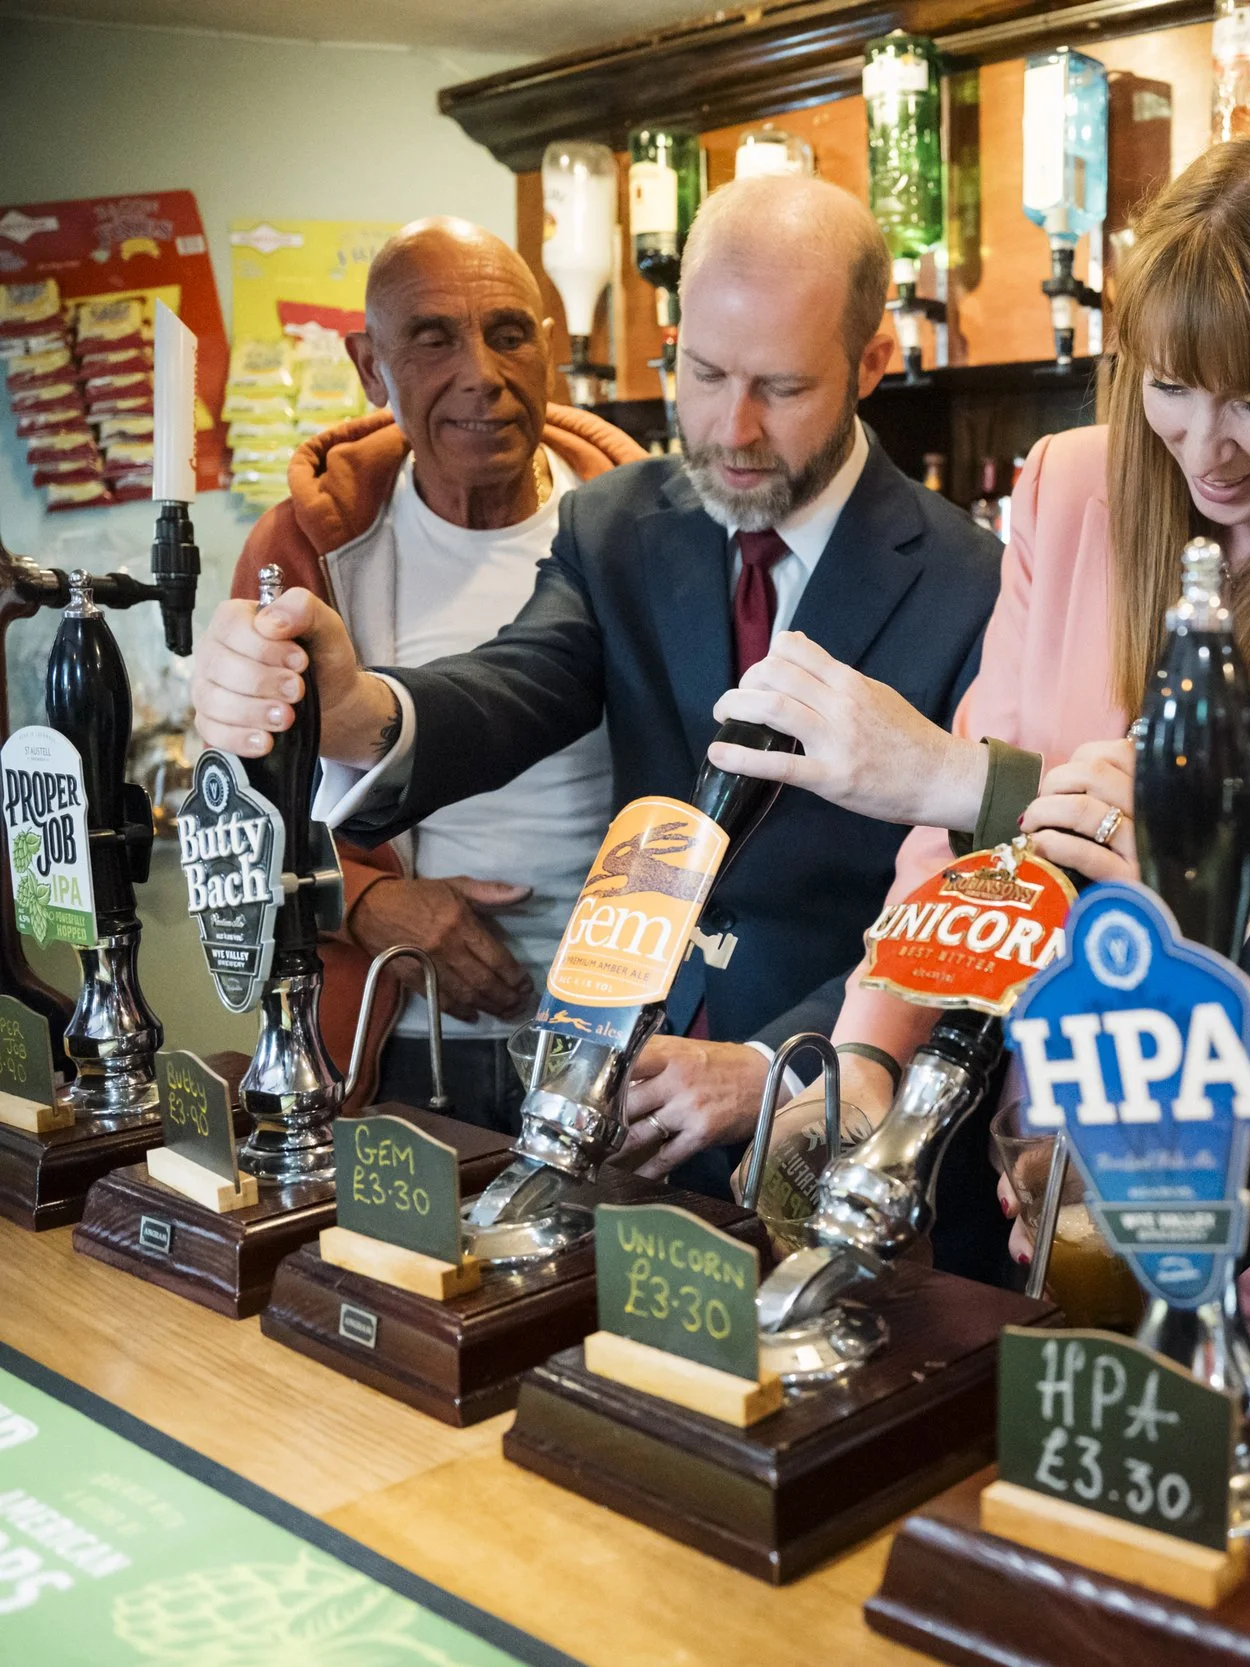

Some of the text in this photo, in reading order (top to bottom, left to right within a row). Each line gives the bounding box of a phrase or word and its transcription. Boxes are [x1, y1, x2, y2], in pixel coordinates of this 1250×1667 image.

[6, 768, 81, 828] PROPER
[37, 812, 77, 877] JOB
[178, 811, 271, 866] Butty
[51, 873, 84, 907] IPA
[184, 851, 273, 912] Bach
[56, 923, 87, 941] HOPPED
[568, 897, 673, 962] Gem
[597, 961, 628, 977] AMBER
[630, 969, 651, 981] ALE
[898, 946, 996, 973] BEST BITTER
[166, 1060, 208, 1114] Butty
[355, 1124, 415, 1176] GEM
[617, 1220, 745, 1290] UNICORN
[1036, 1338, 1180, 1442] HPA
[1035, 1426, 1191, 1520] £3.30
